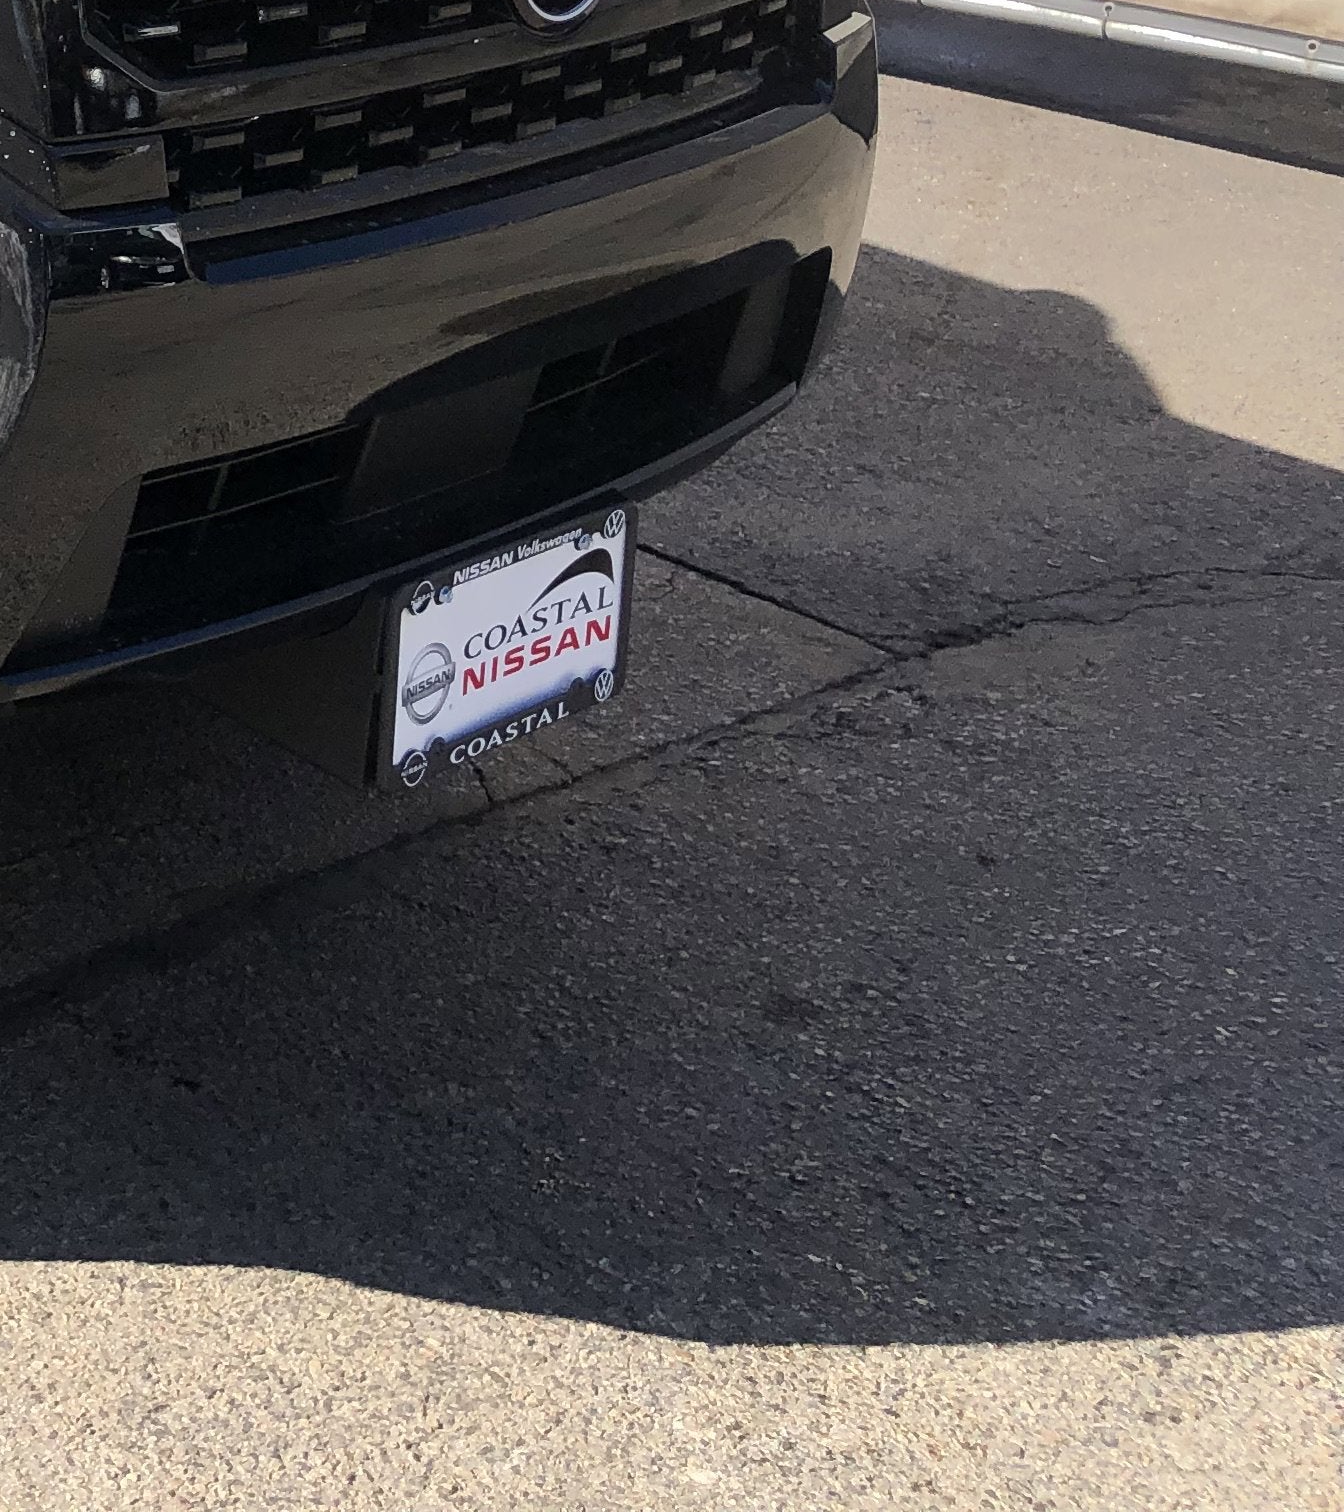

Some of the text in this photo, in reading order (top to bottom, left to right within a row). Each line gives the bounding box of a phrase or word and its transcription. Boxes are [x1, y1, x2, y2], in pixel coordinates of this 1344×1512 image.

[453, 550, 514, 585] NISSAN
[463, 586, 614, 660] COASTAL
[406, 667, 453, 700] NISSAN
[462, 615, 612, 696] NISSAN
[450, 701, 570, 764] COASTAL
